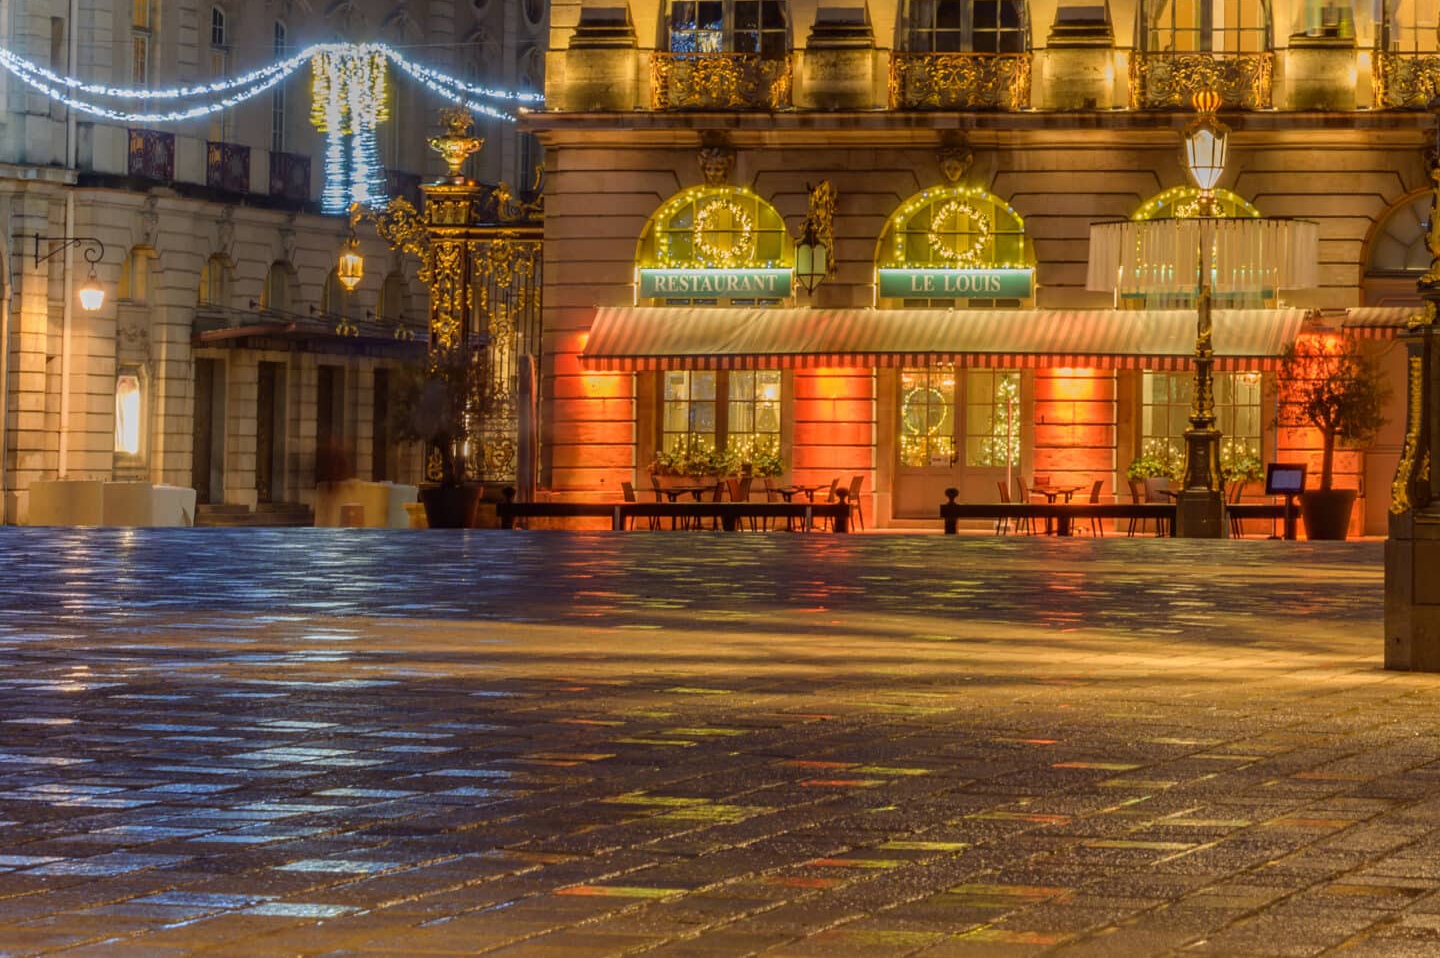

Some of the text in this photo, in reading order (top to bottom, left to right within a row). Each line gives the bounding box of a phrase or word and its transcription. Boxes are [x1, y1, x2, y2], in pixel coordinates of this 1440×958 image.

[654, 274, 778, 292] RESTAURANT
[911, 274, 1001, 292] LE LOUIS
